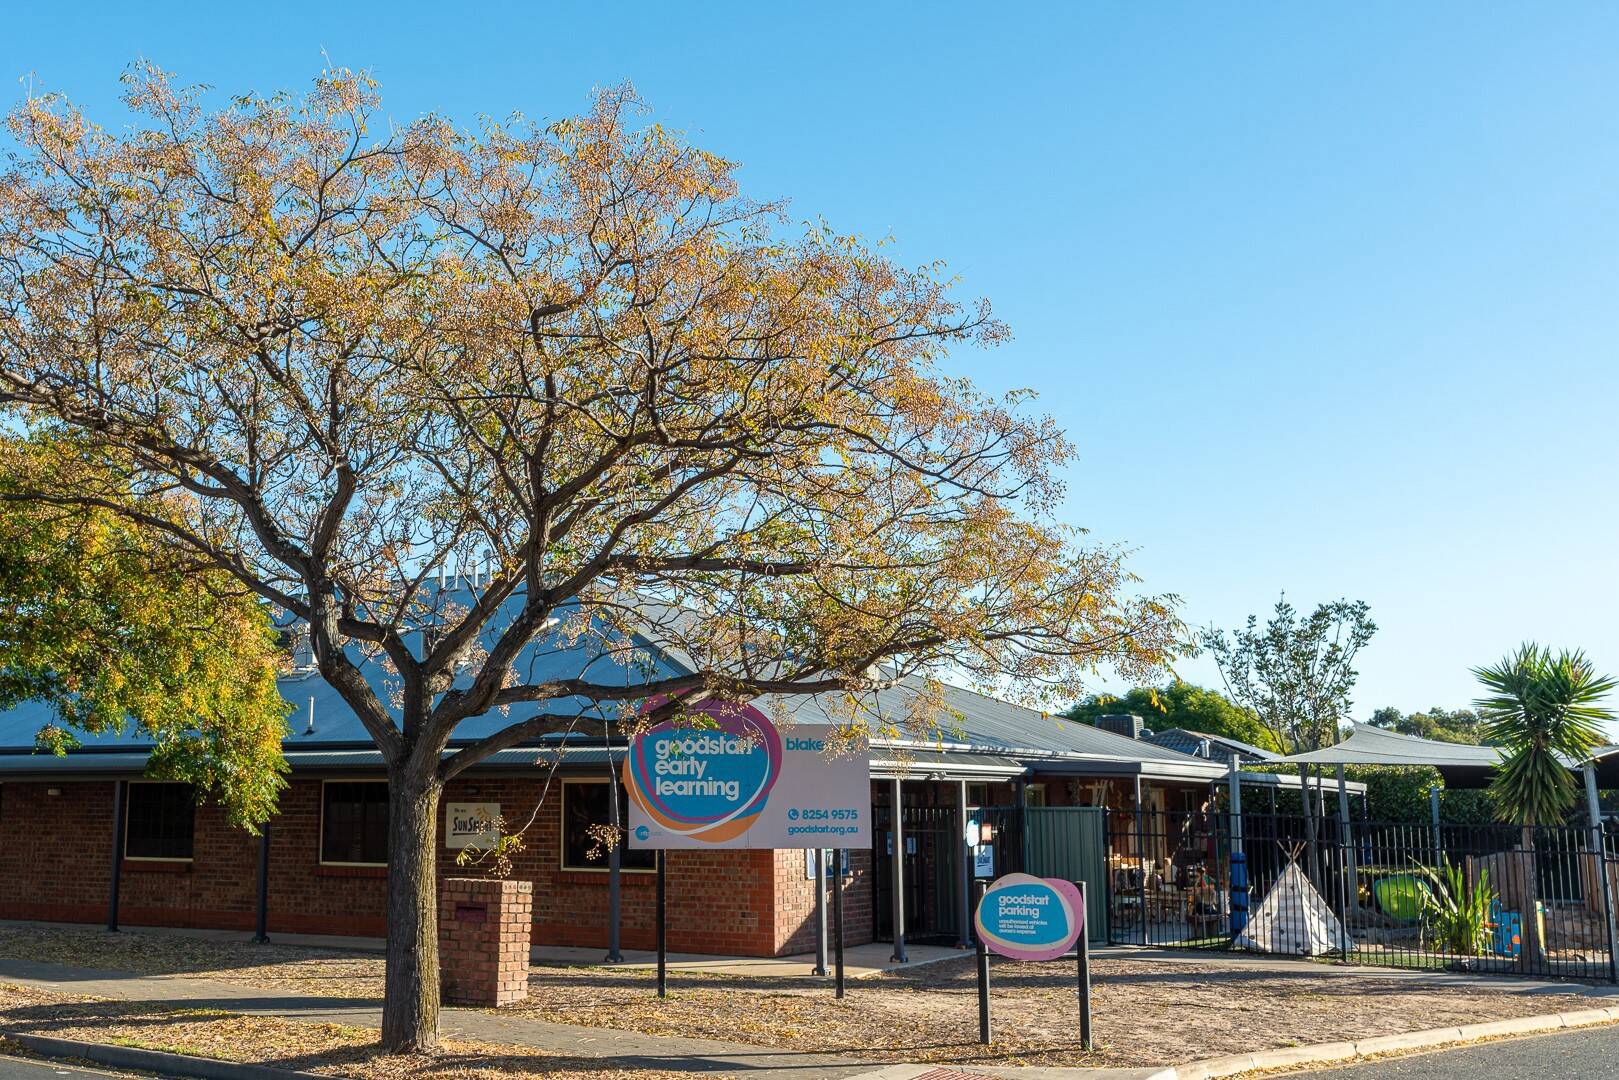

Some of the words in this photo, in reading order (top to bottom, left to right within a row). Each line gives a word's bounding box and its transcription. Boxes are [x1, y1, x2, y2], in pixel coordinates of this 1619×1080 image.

[655, 736, 754, 759] goodstart
[655, 756, 707, 779] early
[656, 777, 739, 801] learning
[802, 809, 829, 820] 8254
[831, 809, 858, 820] 9575
[788, 825, 858, 836] goodstart.org.au
[999, 895, 1049, 906] goodstart
[999, 906, 1039, 918] parking
